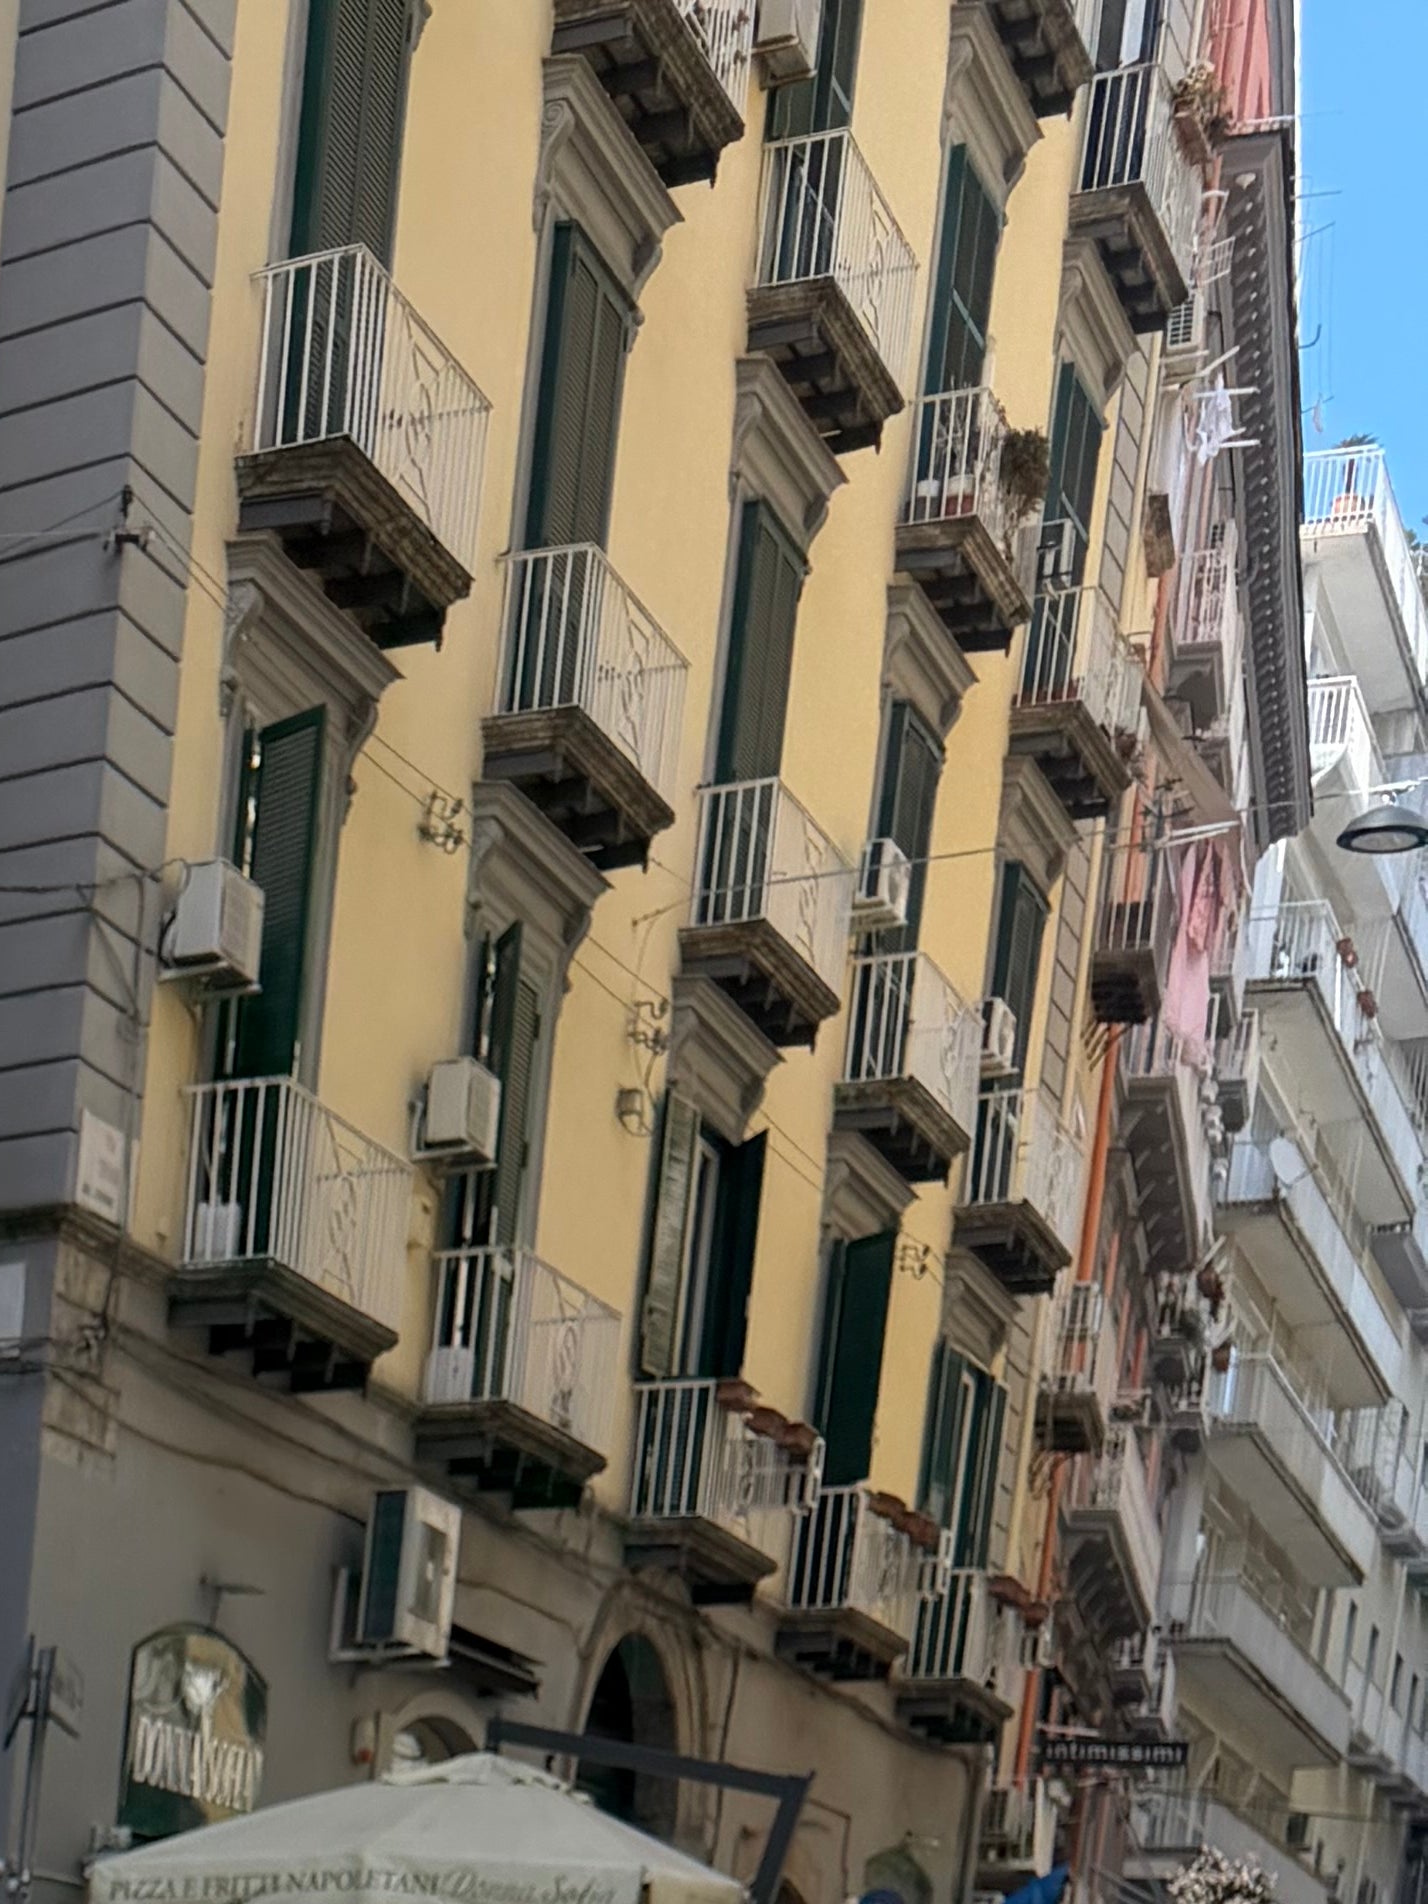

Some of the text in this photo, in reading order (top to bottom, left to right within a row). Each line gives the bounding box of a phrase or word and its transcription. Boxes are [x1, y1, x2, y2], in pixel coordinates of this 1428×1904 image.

[1046, 1743, 1182, 1763] intimissimi
[110, 1878, 176, 1900] PIZZA
[184, 1877, 195, 1898] E
[281, 1869, 439, 1896] NAPOLETANI
